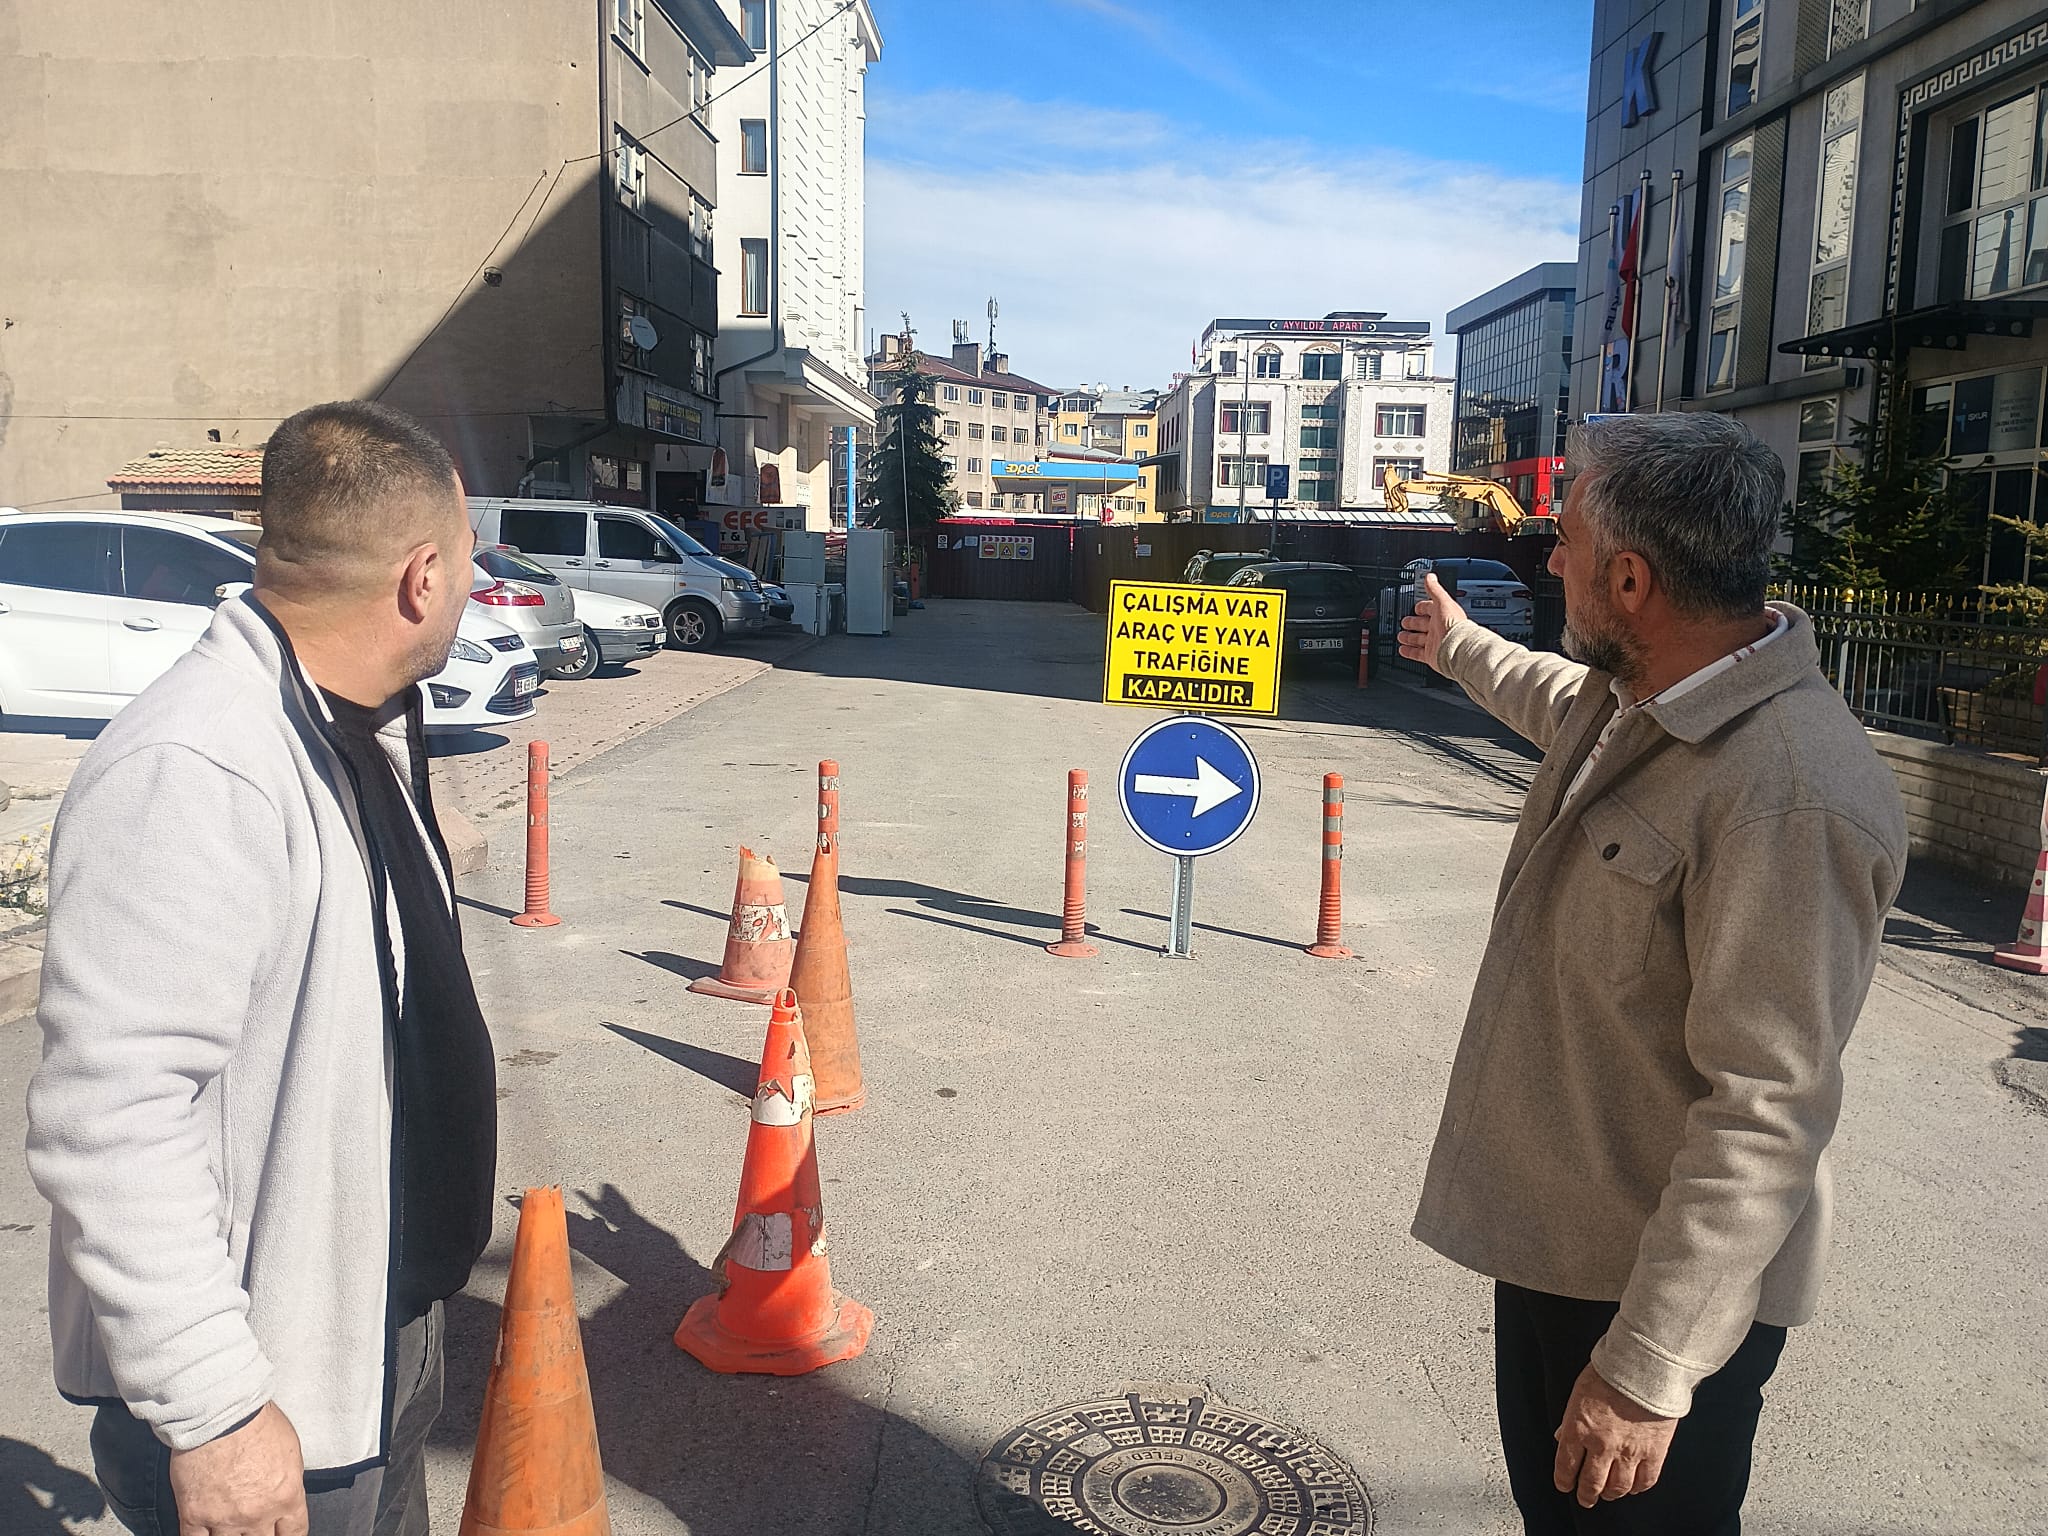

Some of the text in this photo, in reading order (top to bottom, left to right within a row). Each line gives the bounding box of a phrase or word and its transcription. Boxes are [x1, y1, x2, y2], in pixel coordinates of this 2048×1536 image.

[1283, 320, 1364, 331] AYYILDIZ APART
[1271, 468, 1284, 487] P
[724, 511, 769, 530] EFE
[1123, 592, 1268, 618] ÇALIŞMA VAR
[1116, 621, 1270, 648] ARAÇ VE YAYA
[1316, 640, 1327, 648] TF
[1134, 650, 1249, 675] TRAFİĞİNE
